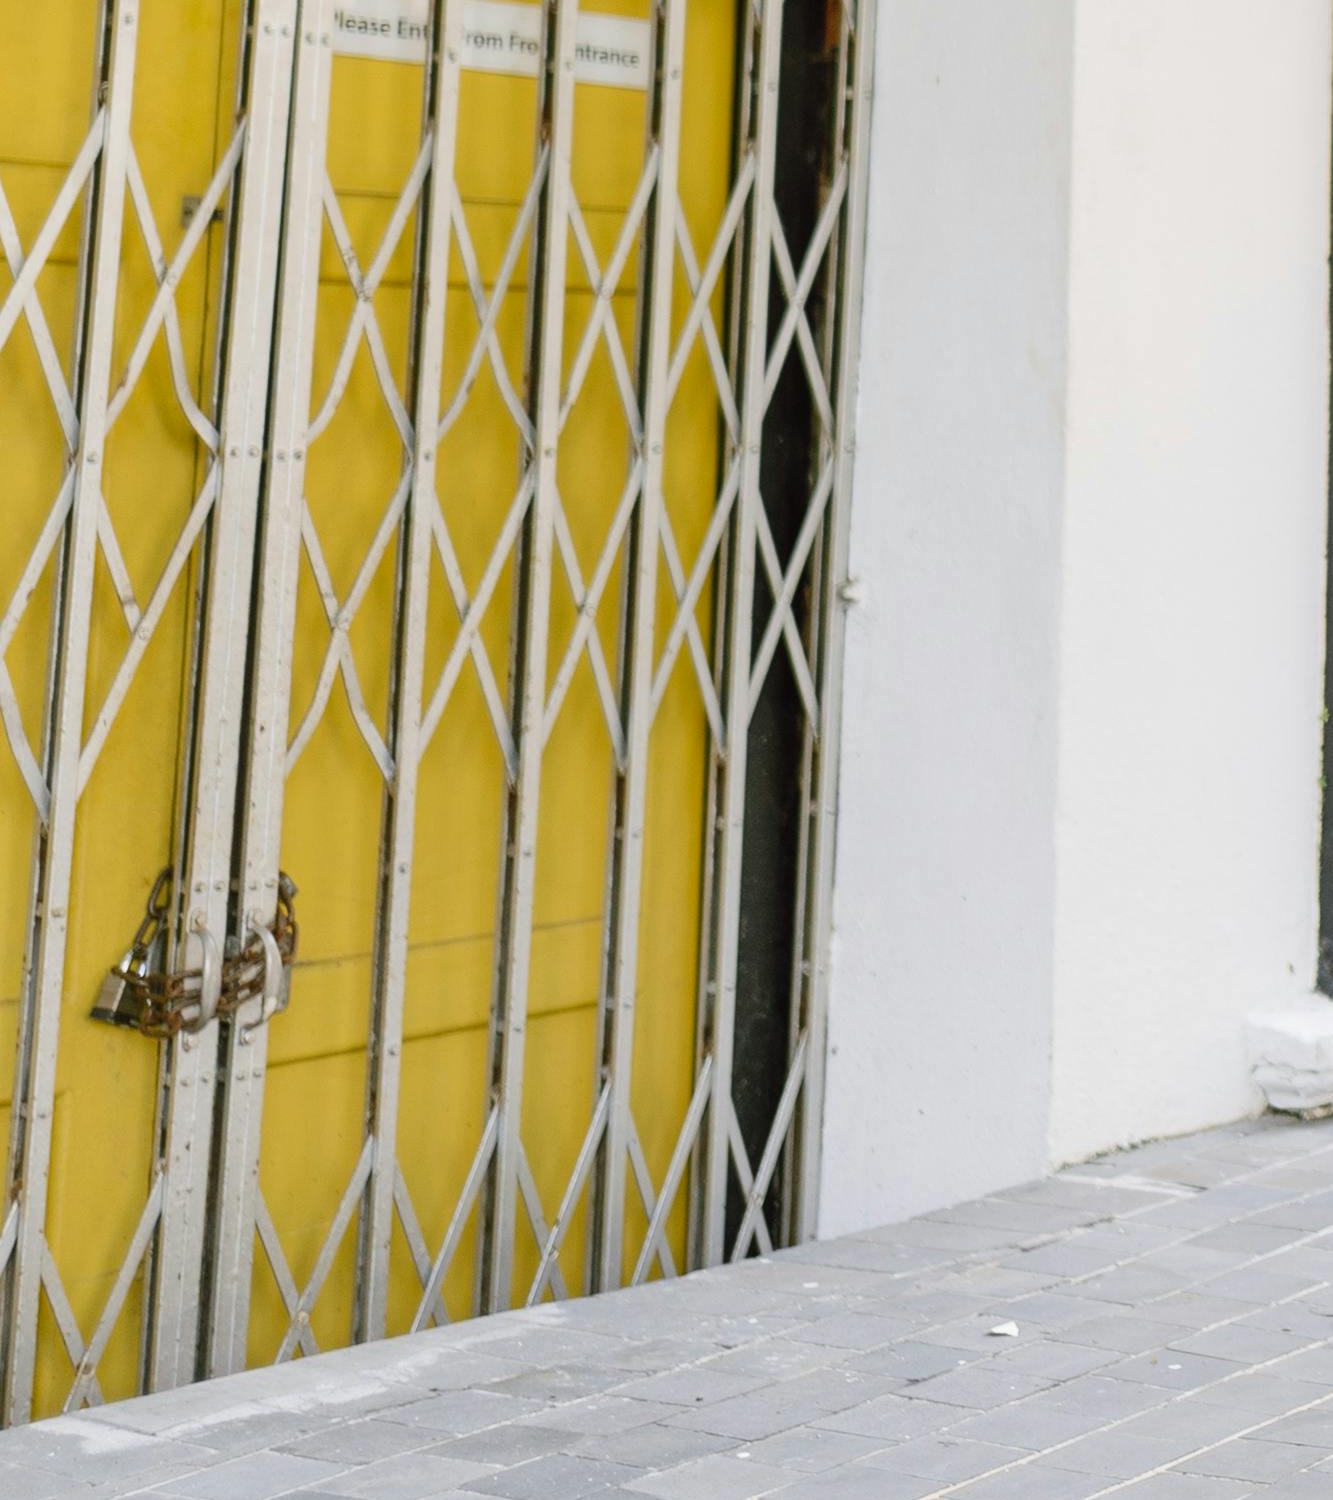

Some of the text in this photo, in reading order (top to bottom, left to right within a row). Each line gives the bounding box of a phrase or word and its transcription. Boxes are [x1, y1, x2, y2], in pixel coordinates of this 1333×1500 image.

[334, 9, 639, 69] lease Ent rom Fro ntrance
